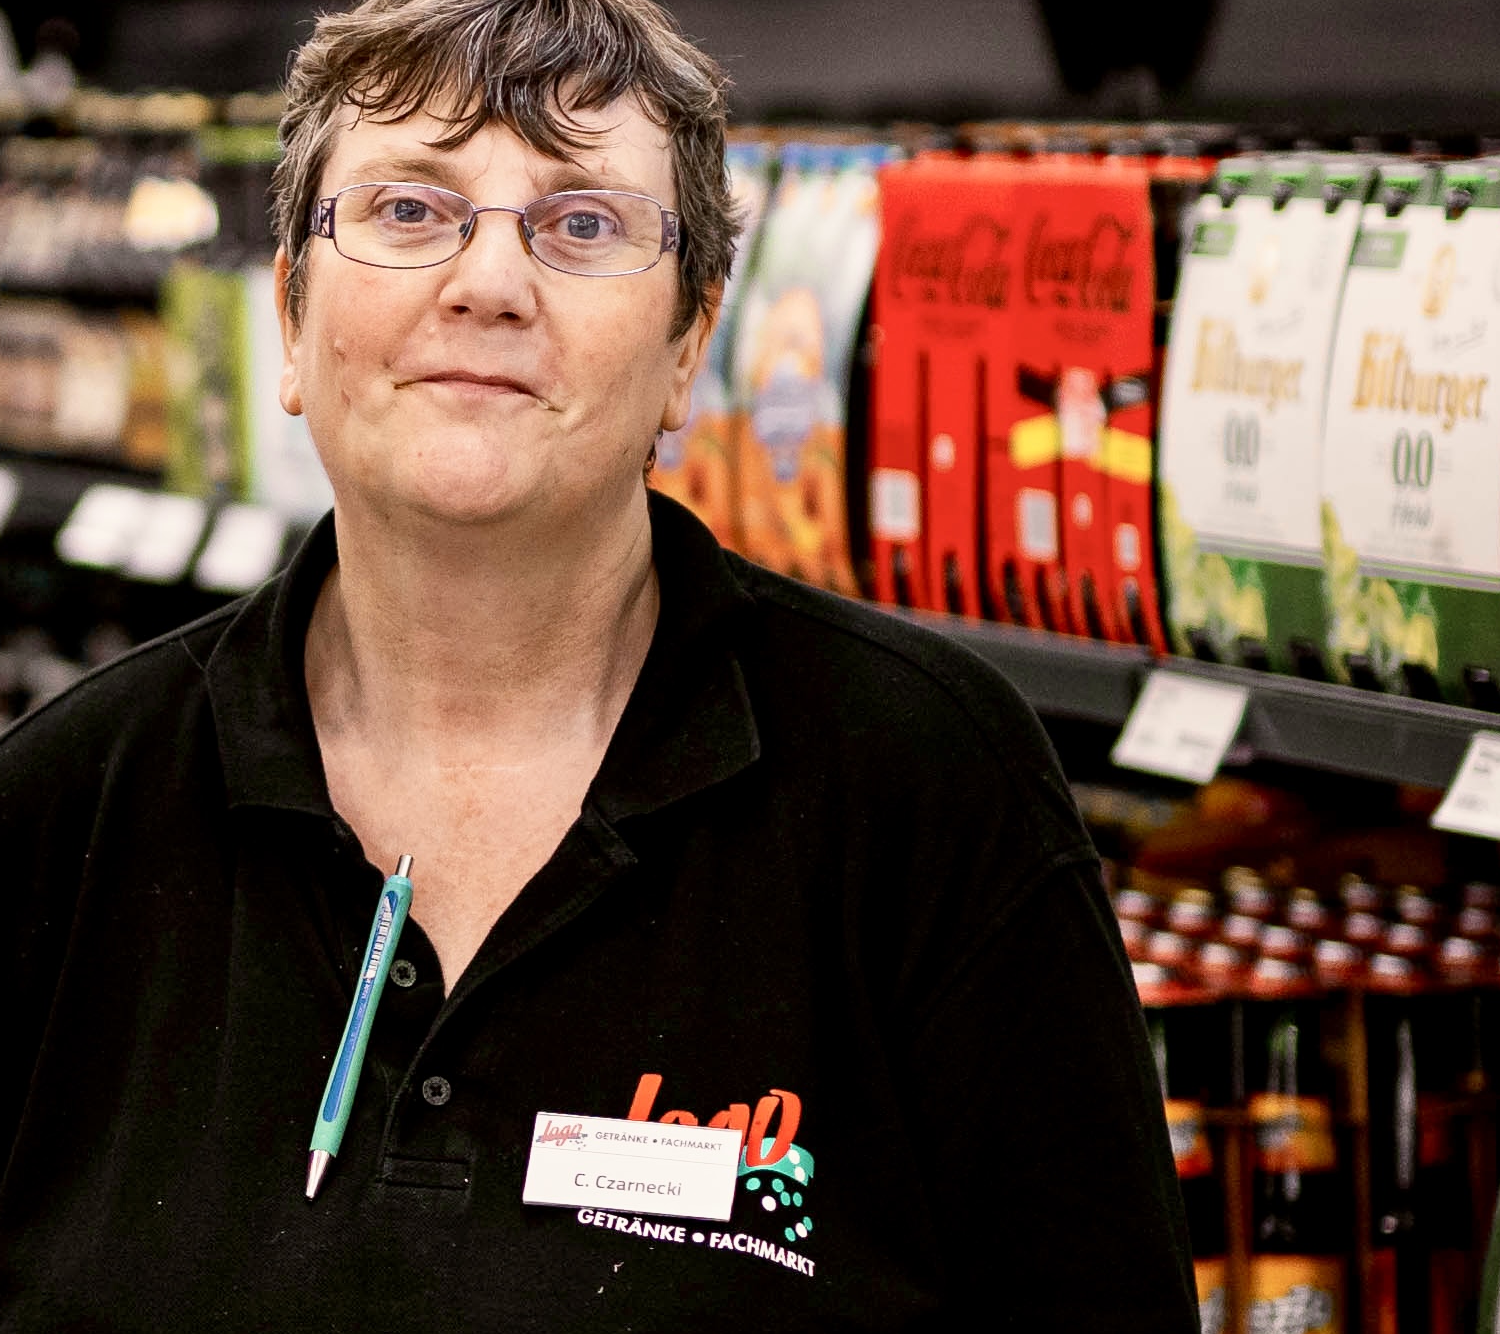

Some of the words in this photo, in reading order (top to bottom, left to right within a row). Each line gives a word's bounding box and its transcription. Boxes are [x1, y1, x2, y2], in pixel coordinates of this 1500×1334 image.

[1353, 330, 1488, 433] Bitburger
[595, 1130, 649, 1144] GETRÄNKE
[661, 1138, 722, 1151] FACHMARKT
[574, 1173, 589, 1188] C.
[596, 1175, 682, 1197] Czarnecki
[577, 1208, 686, 1244] GETRÄNKE
[710, 1232, 815, 1277] FACHMARKT
